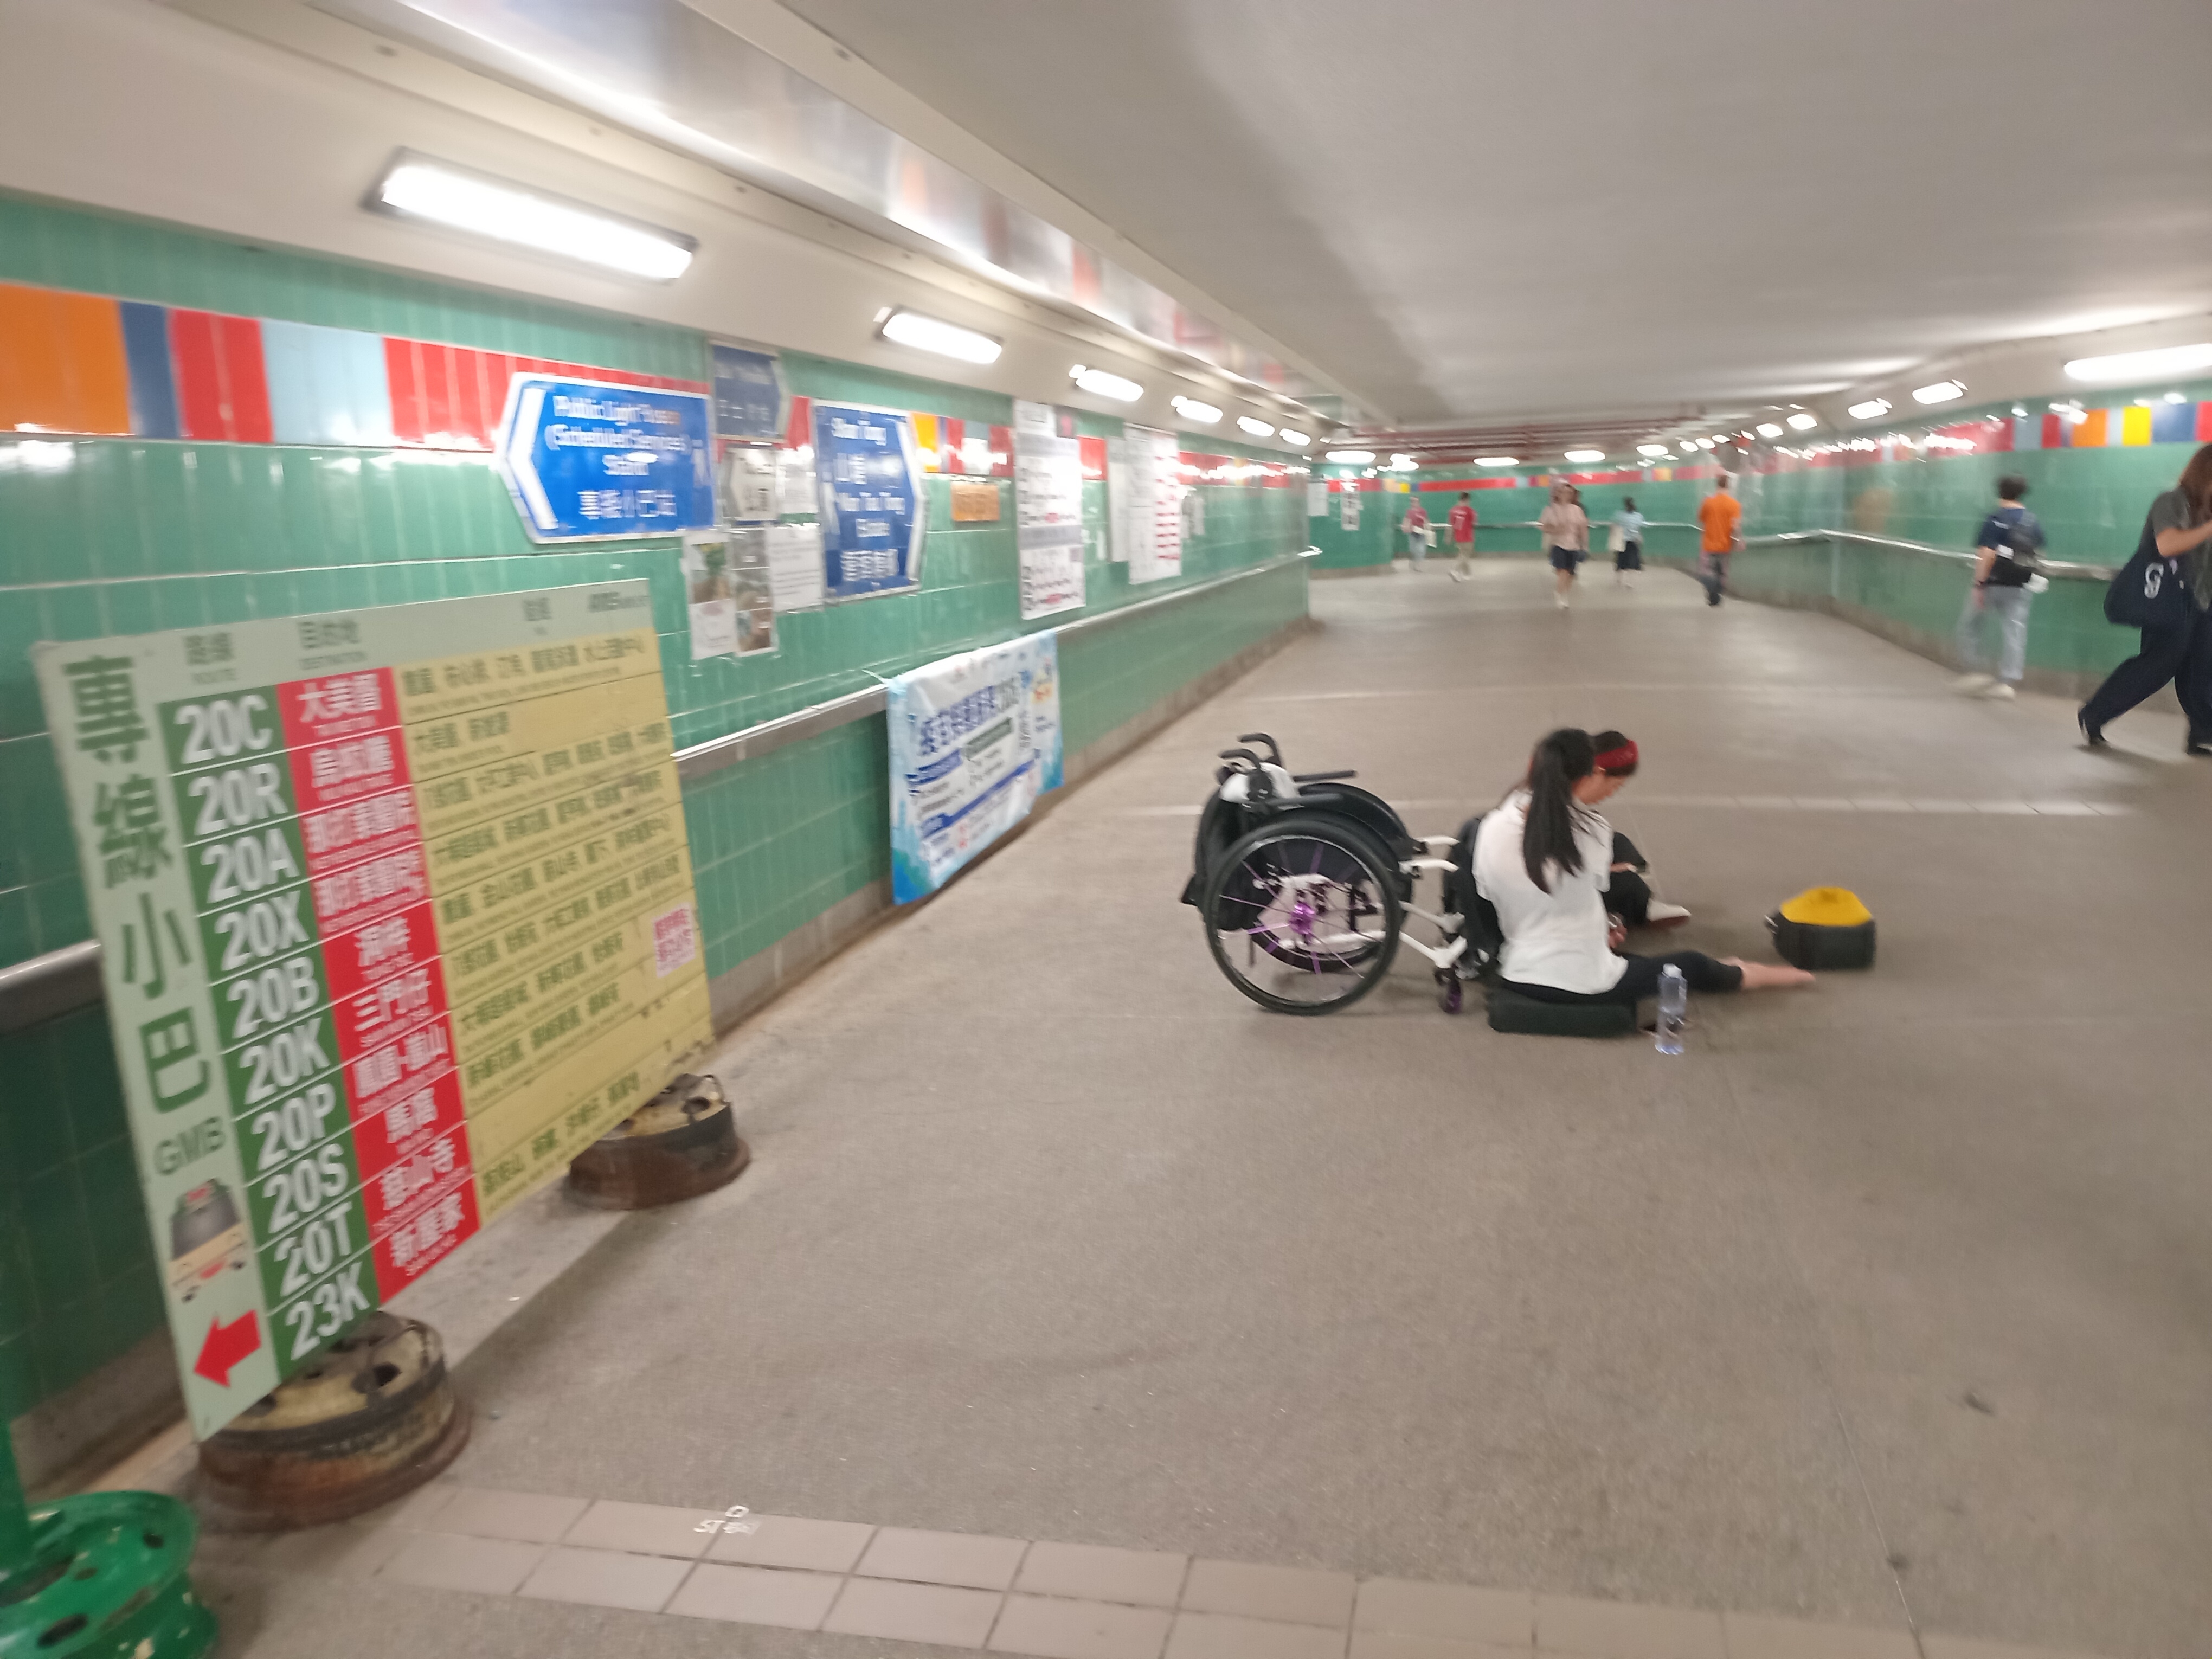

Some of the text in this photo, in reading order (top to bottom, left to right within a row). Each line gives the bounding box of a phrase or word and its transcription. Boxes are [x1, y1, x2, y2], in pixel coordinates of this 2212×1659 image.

[173, 695, 273, 764] 20C
[188, 763, 287, 835] 20R
[62, 655, 211, 1114] 專線小巴
[199, 828, 300, 904] 20A
[214, 890, 309, 971] 20X
[227, 956, 320, 1039] 20B
[350, 964, 434, 1038] 三門仔
[240, 1017, 330, 1105] 20K
[152, 1115, 226, 1176] GMB
[251, 1082, 336, 1173] 20P
[262, 1143, 348, 1234] 20S
[273, 1201, 352, 1297] 20T
[286, 1262, 370, 1361] 23K
